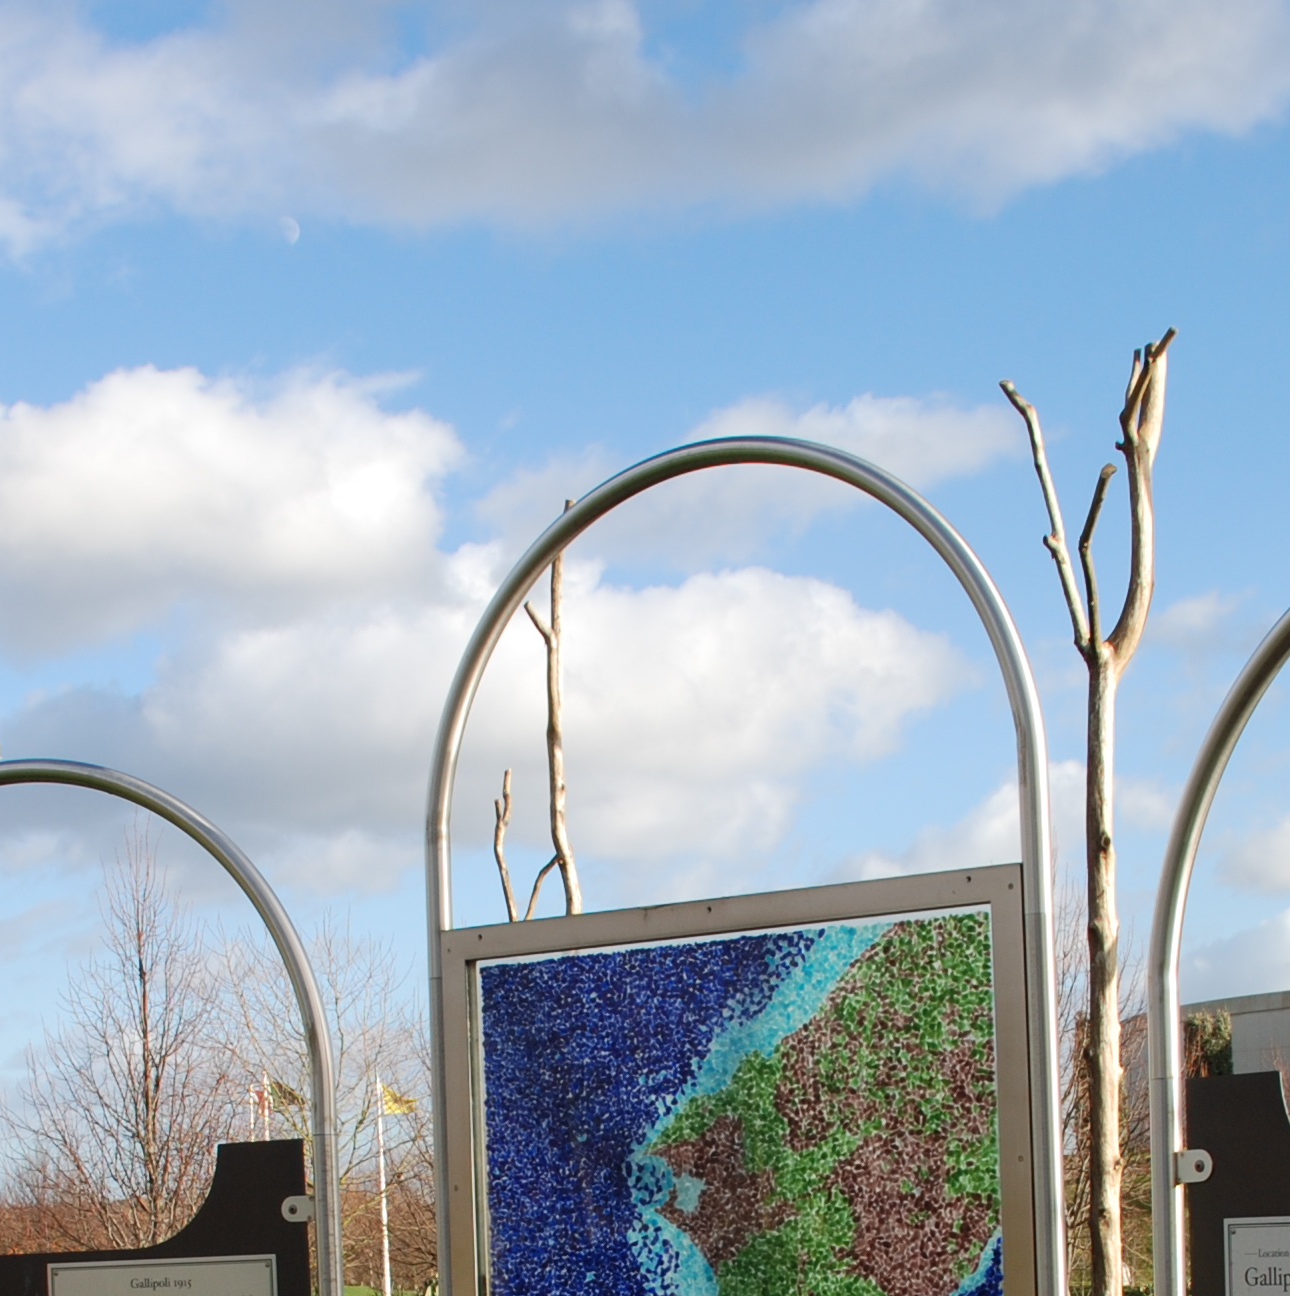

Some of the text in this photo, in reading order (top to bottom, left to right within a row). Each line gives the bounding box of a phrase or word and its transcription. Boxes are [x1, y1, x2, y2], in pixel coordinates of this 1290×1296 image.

[1258, 1248, 1290, 1258] Location
[130, 1277, 192, 1291] Gallipoli 1915
